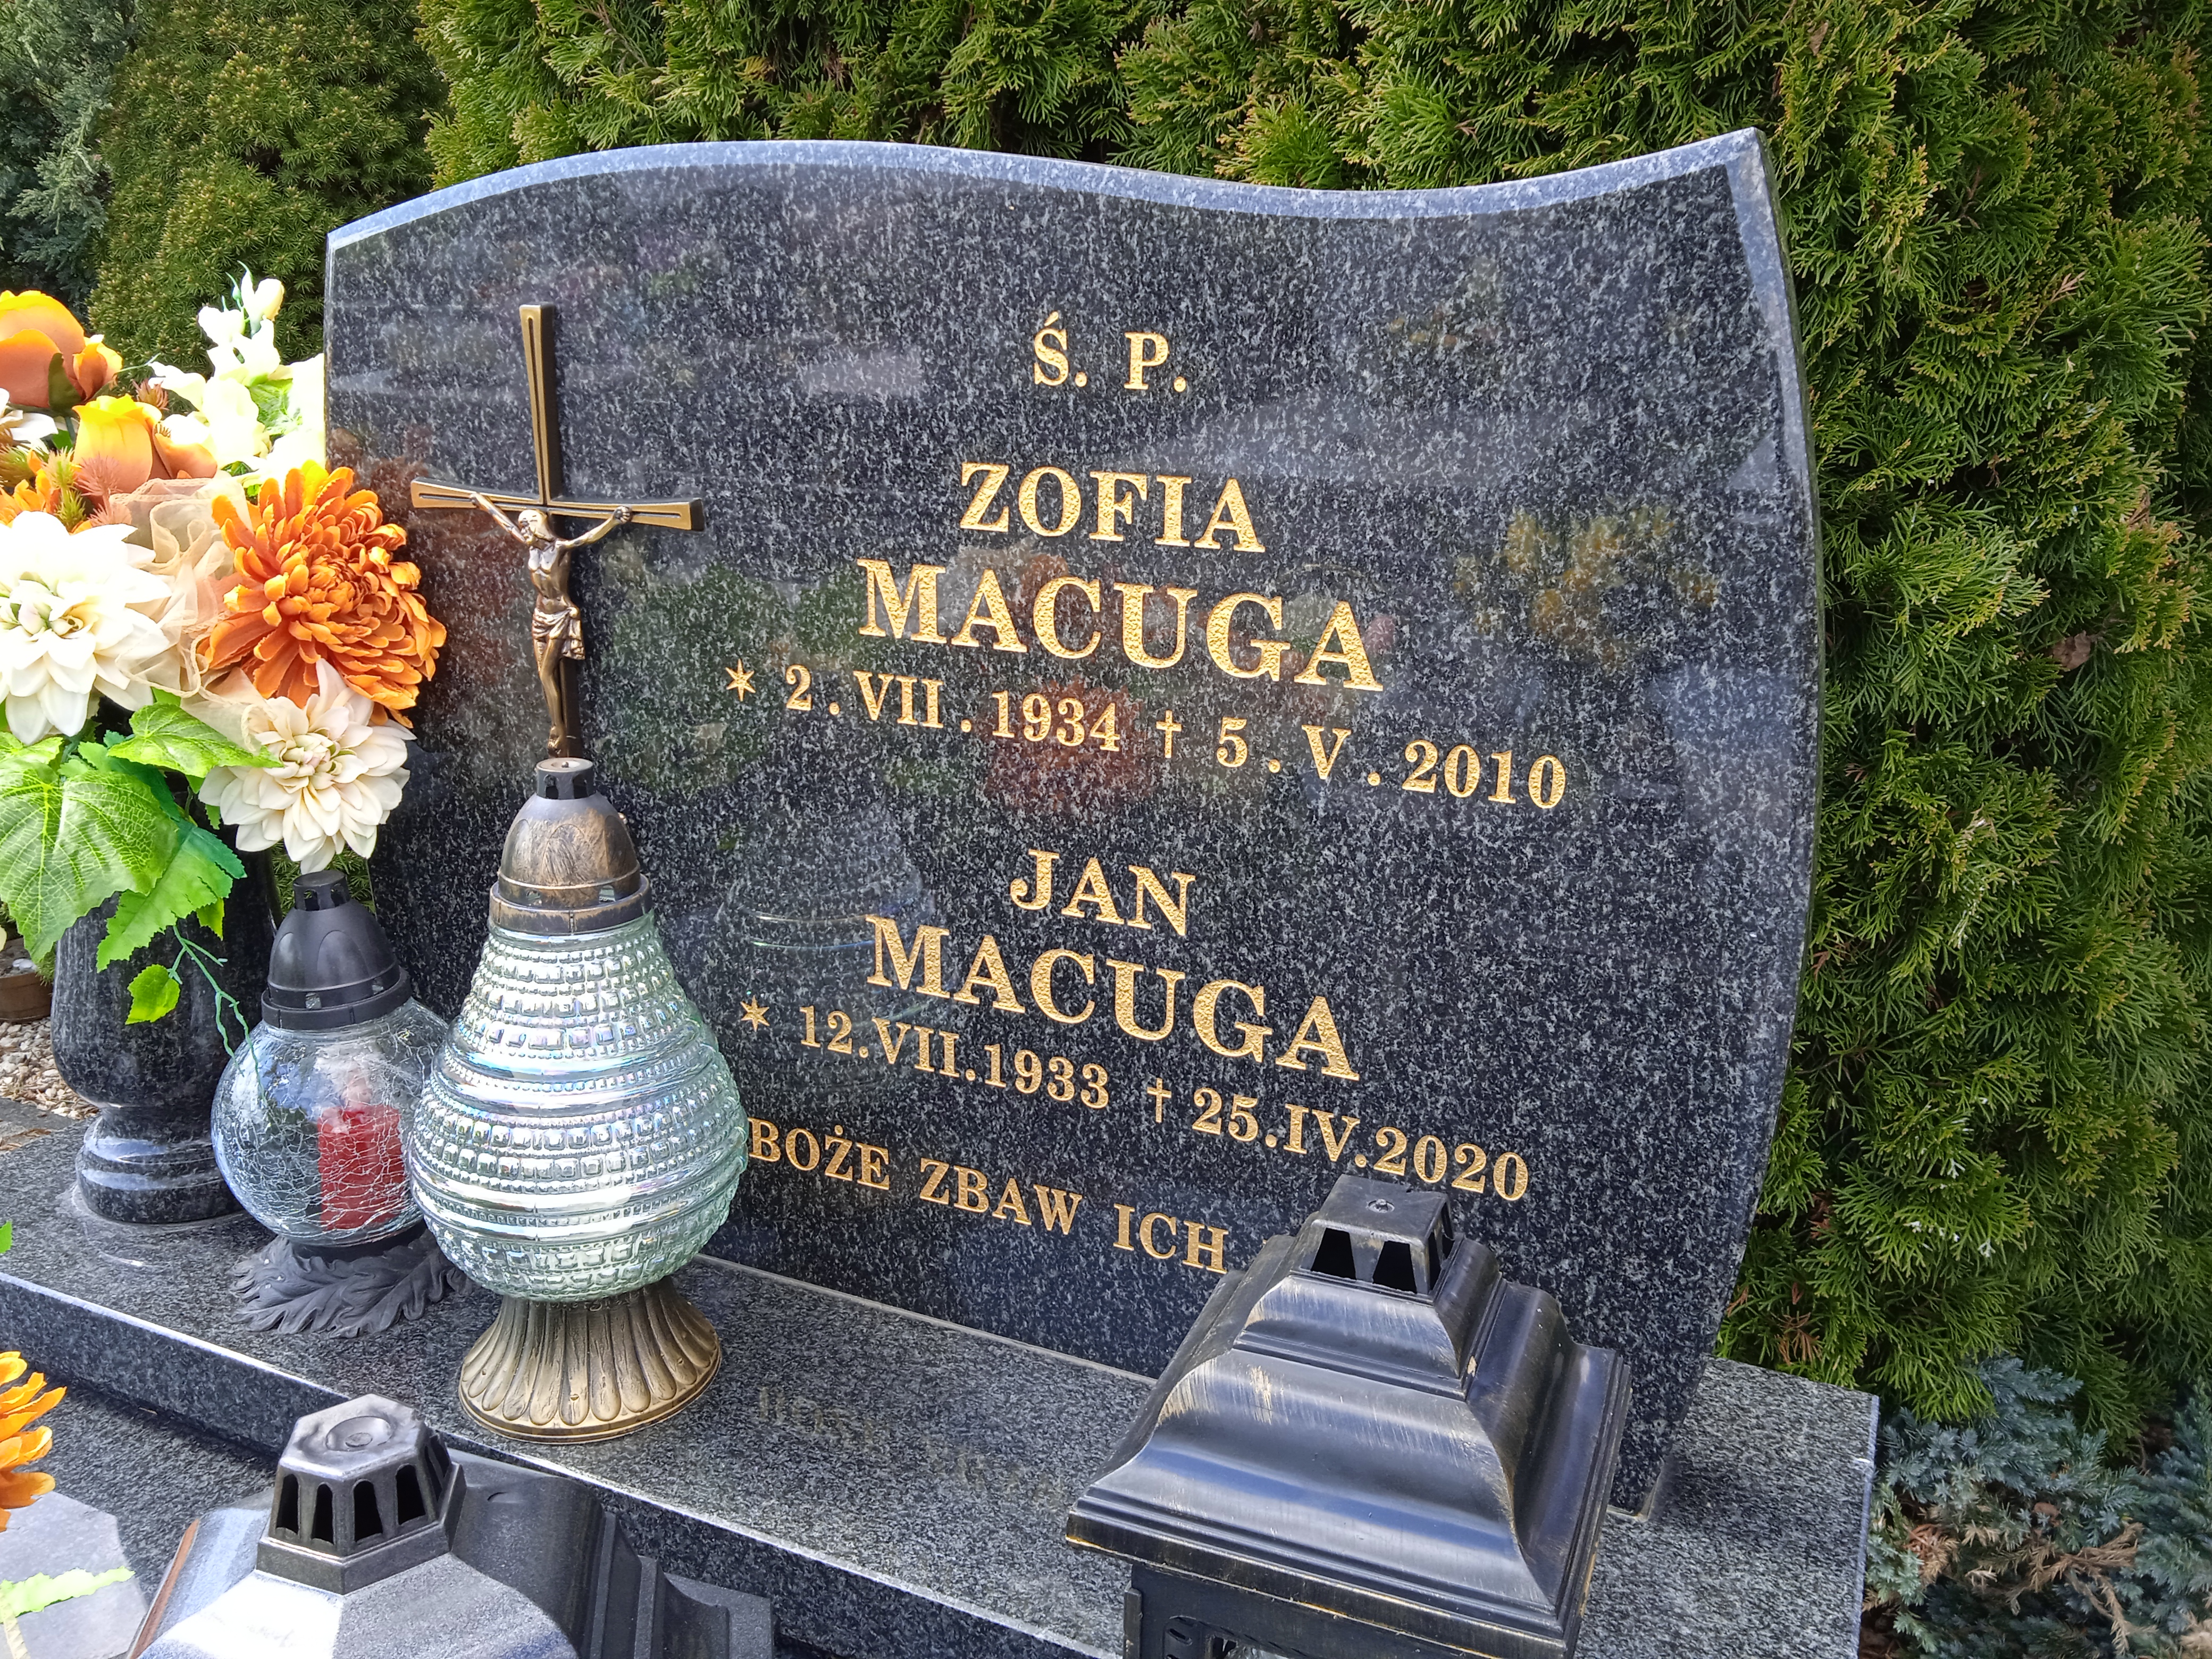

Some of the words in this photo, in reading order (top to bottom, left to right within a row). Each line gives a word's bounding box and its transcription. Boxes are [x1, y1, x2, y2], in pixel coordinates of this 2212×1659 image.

[959, 461, 1266, 552] ZOFIA
[857, 558, 1383, 692] MACUGA
[1010, 849, 1196, 935] JAN
[865, 914, 1360, 1081] MACUGA
[748, 1117, 890, 1190] BOŻE
[920, 1158, 1083, 1234] ZBAW
[1113, 1203, 1229, 1274] ICH
